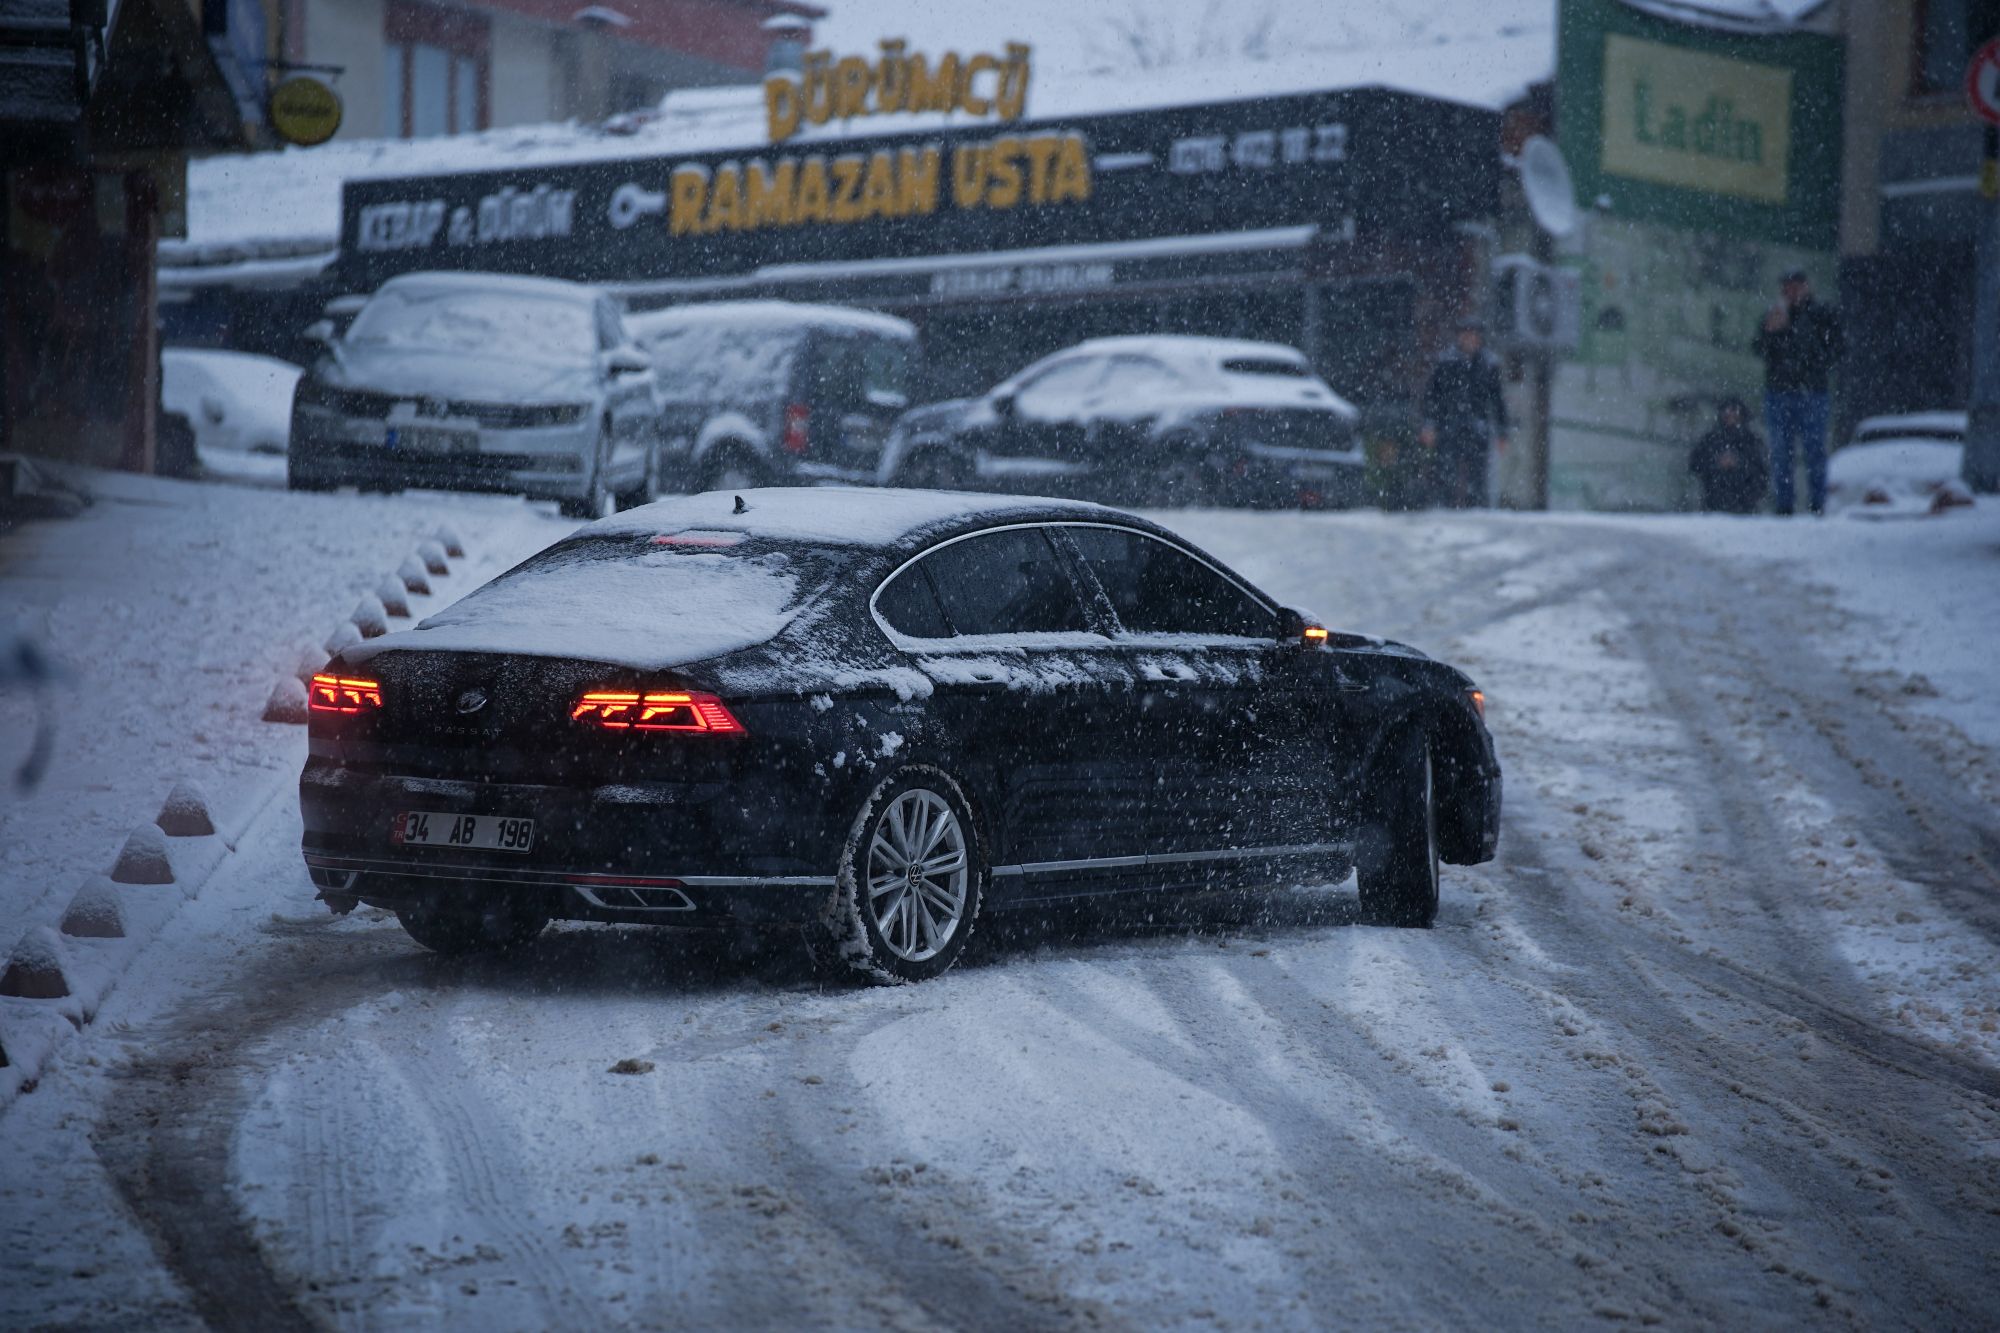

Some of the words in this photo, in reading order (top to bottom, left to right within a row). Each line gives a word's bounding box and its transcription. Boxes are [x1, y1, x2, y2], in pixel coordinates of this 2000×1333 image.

[765, 41, 1032, 142] DÜRÜMCÜ
[1634, 76, 1763, 165] Ladin
[670, 148, 941, 236] RAMAZAN
[953, 132, 1092, 209] USTA
[434, 726, 502, 736] PASSAT
[405, 813, 429, 842] 34
[449, 816, 476, 845] AB
[497, 818, 532, 849] 198
